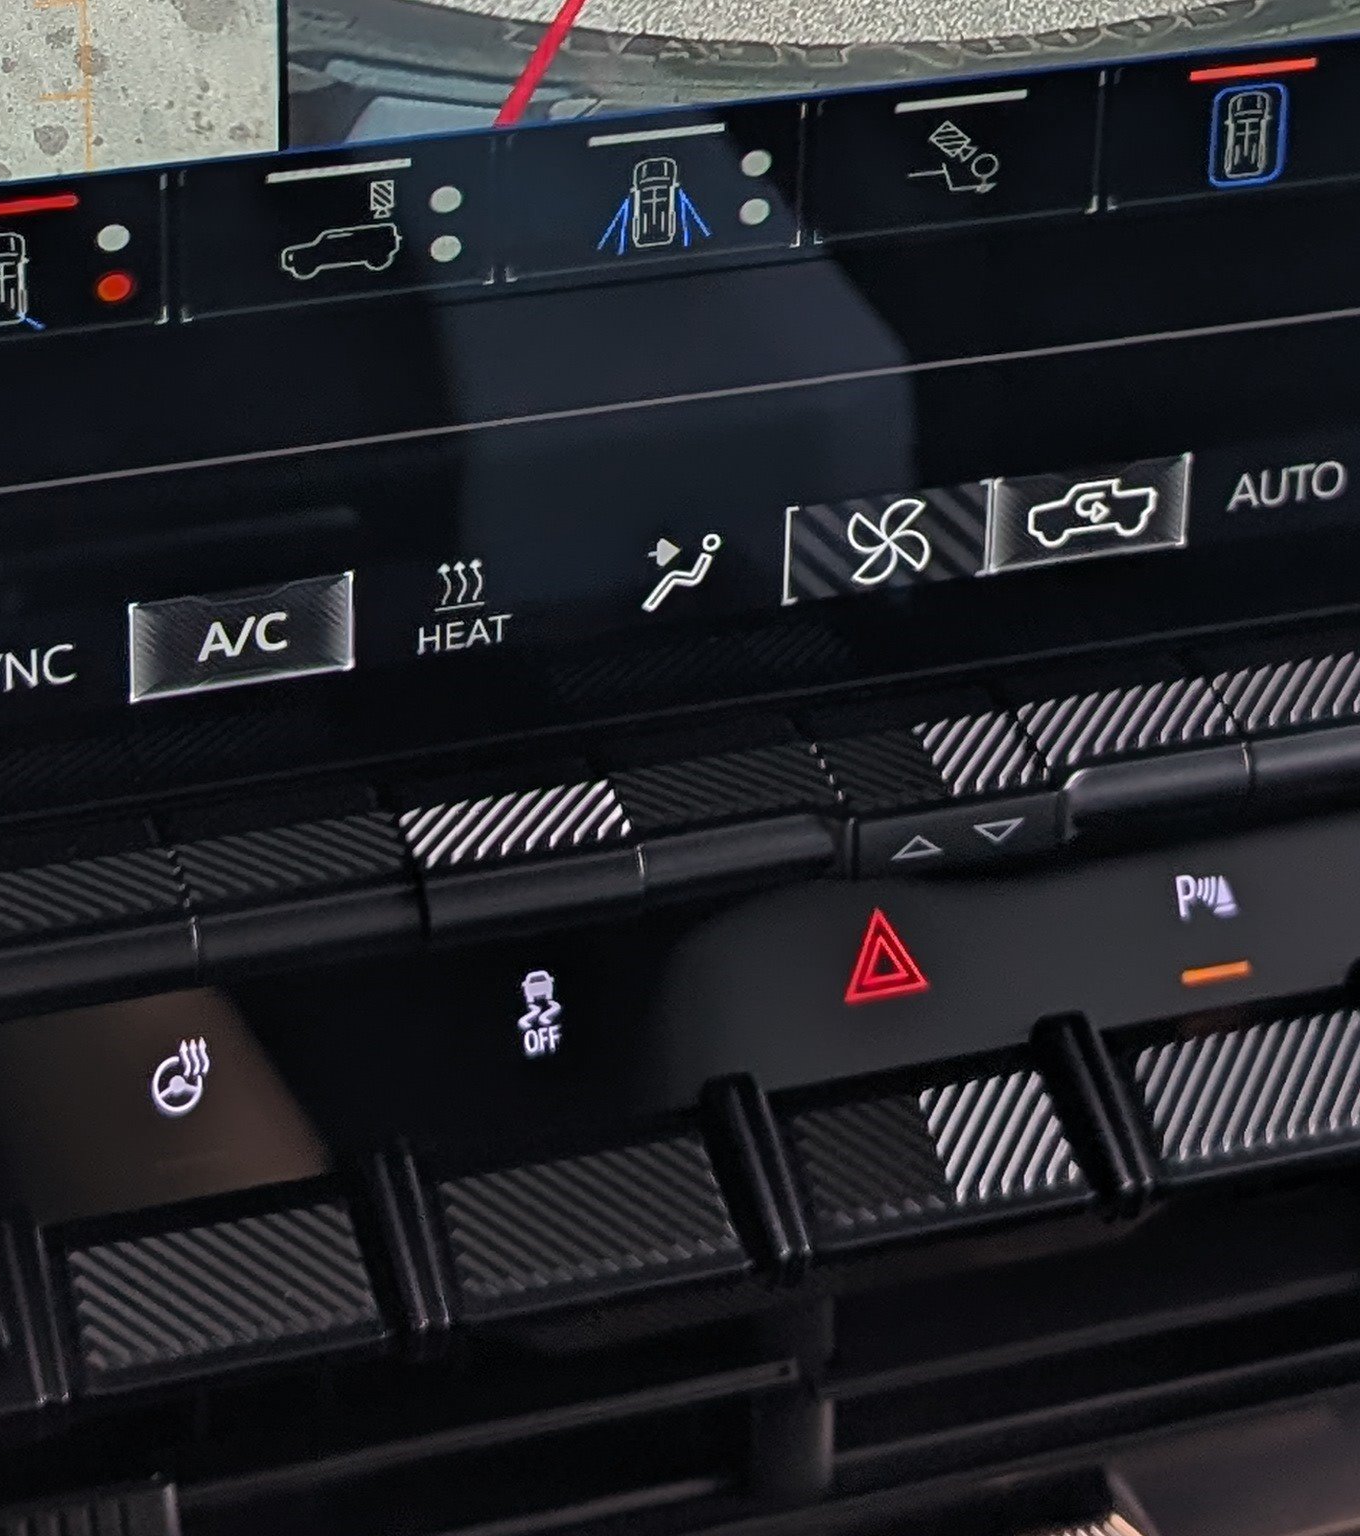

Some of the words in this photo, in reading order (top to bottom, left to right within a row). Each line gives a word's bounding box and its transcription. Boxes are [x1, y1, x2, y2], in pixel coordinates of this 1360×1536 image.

[1227, 461, 1346, 511] AUTO
[198, 612, 288, 662] A/C
[417, 613, 511, 655] HEAT
[523, 1025, 561, 1056] OFF
